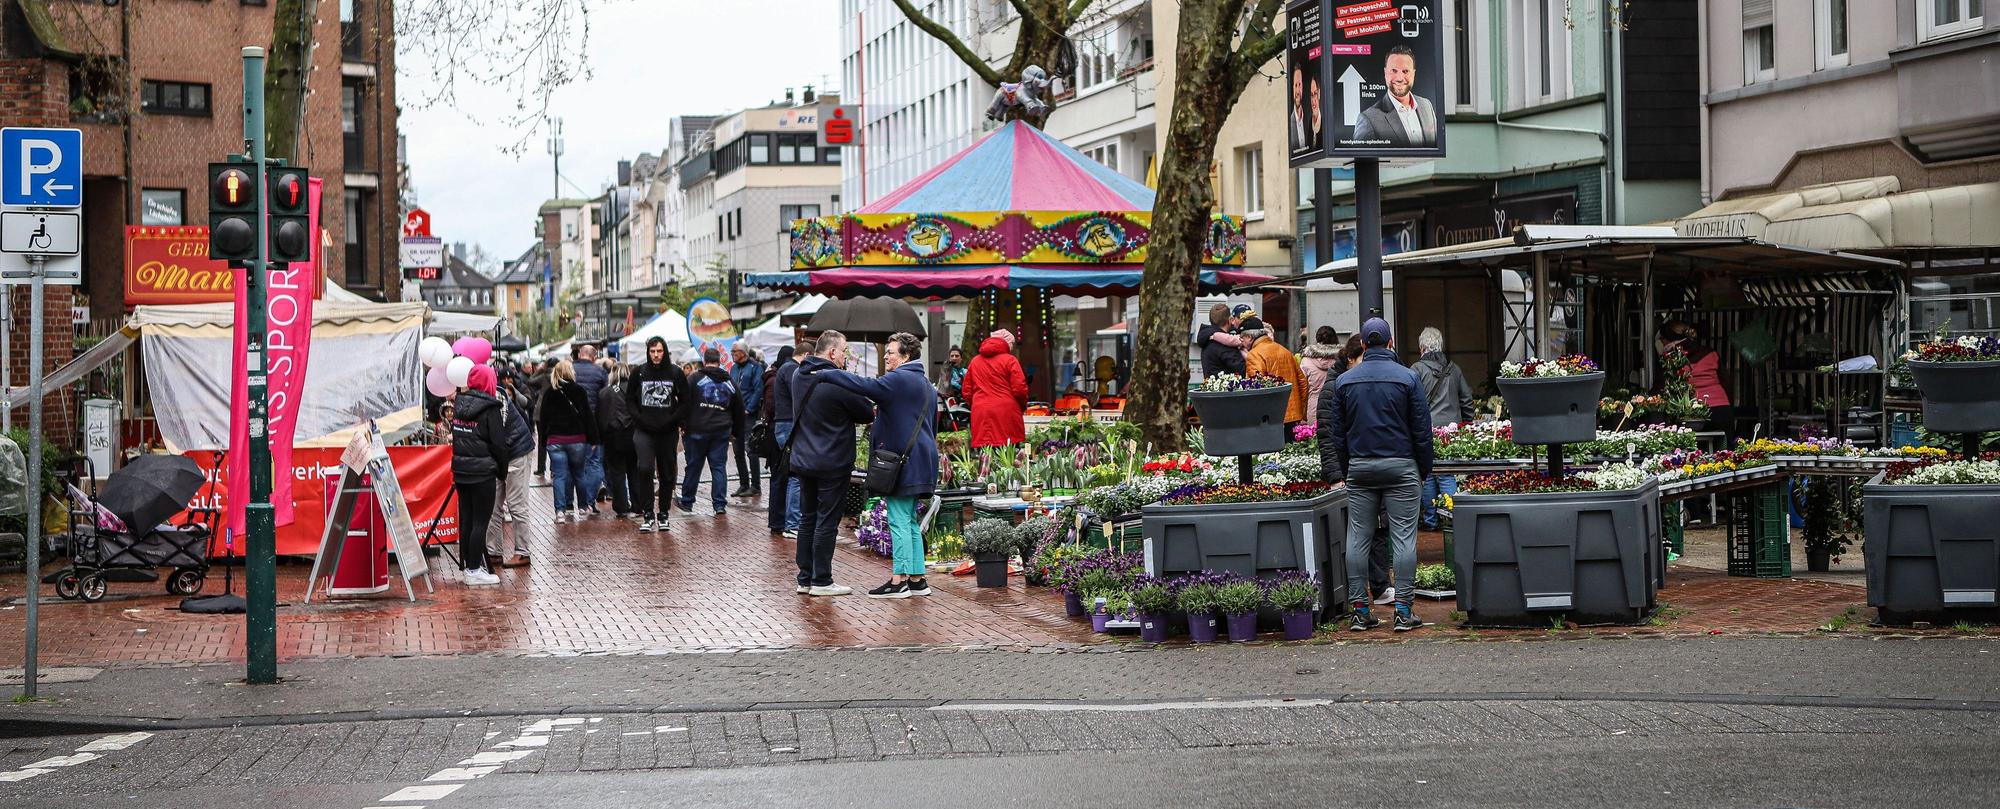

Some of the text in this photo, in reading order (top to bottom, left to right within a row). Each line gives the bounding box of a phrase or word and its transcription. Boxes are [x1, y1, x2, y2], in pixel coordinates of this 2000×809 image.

[1346, 28, 1358, 36] und
[21, 139, 62, 195] P
[136, 261, 235, 290] Man
[292, 461, 325, 480] erk
